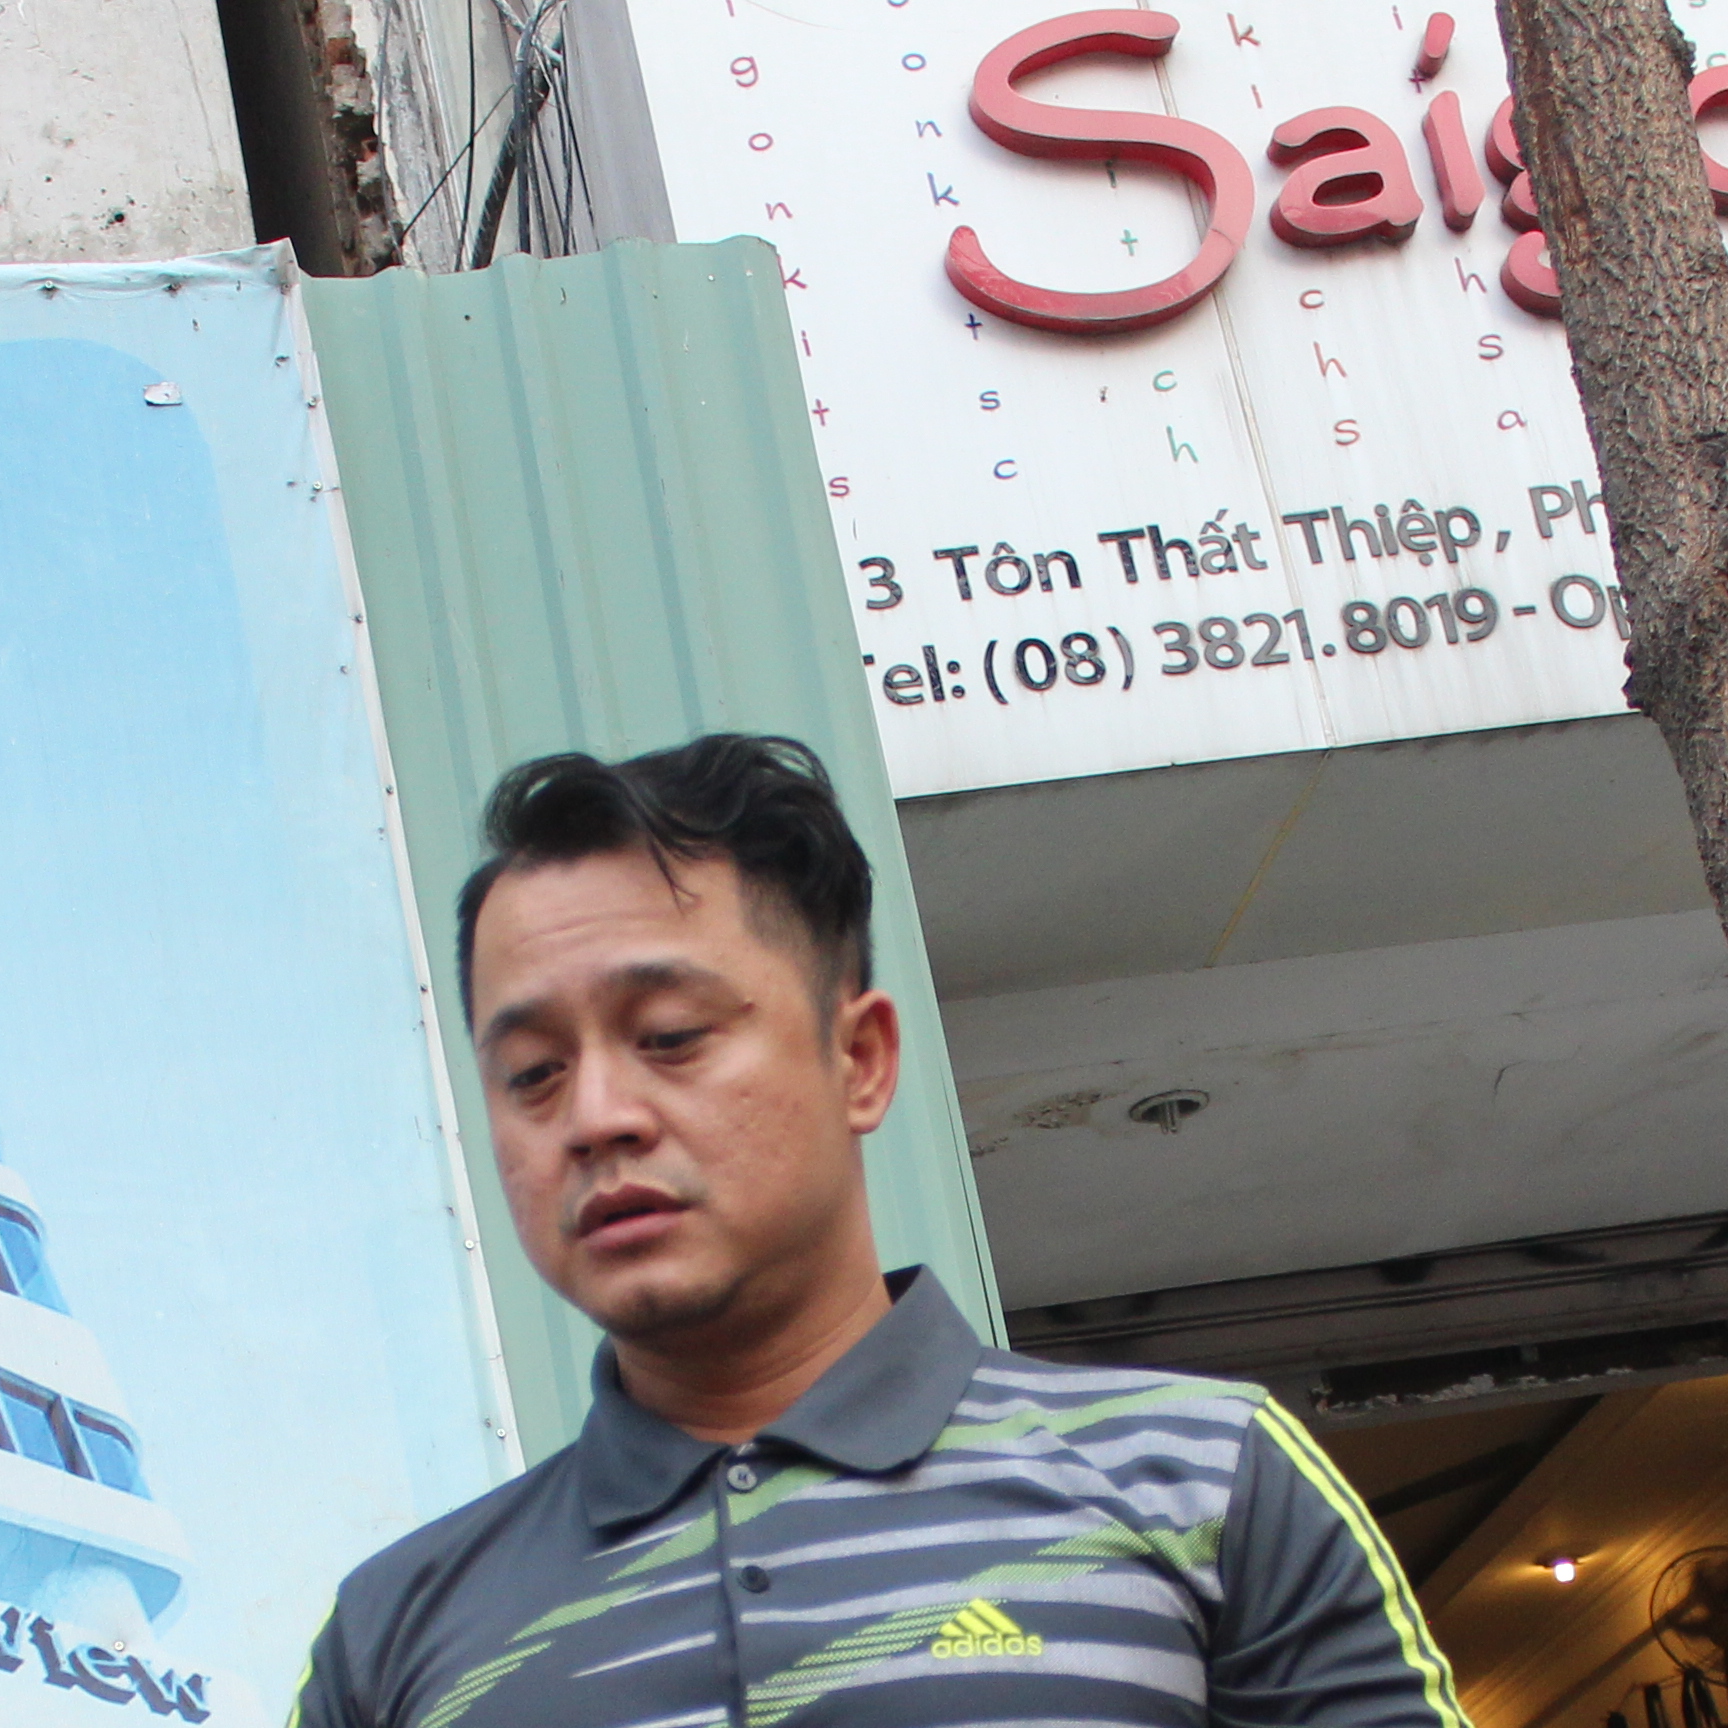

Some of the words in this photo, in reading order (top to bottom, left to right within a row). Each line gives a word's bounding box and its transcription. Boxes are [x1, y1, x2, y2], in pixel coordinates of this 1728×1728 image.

[933, 542, 1082, 601] Tôn
[1098, 508, 1269, 584] Thất
[983, 626, 1136, 705] (08)
[1153, 587, 1499, 674] 3821.8019
[931, 1632, 1043, 1659] adidas
